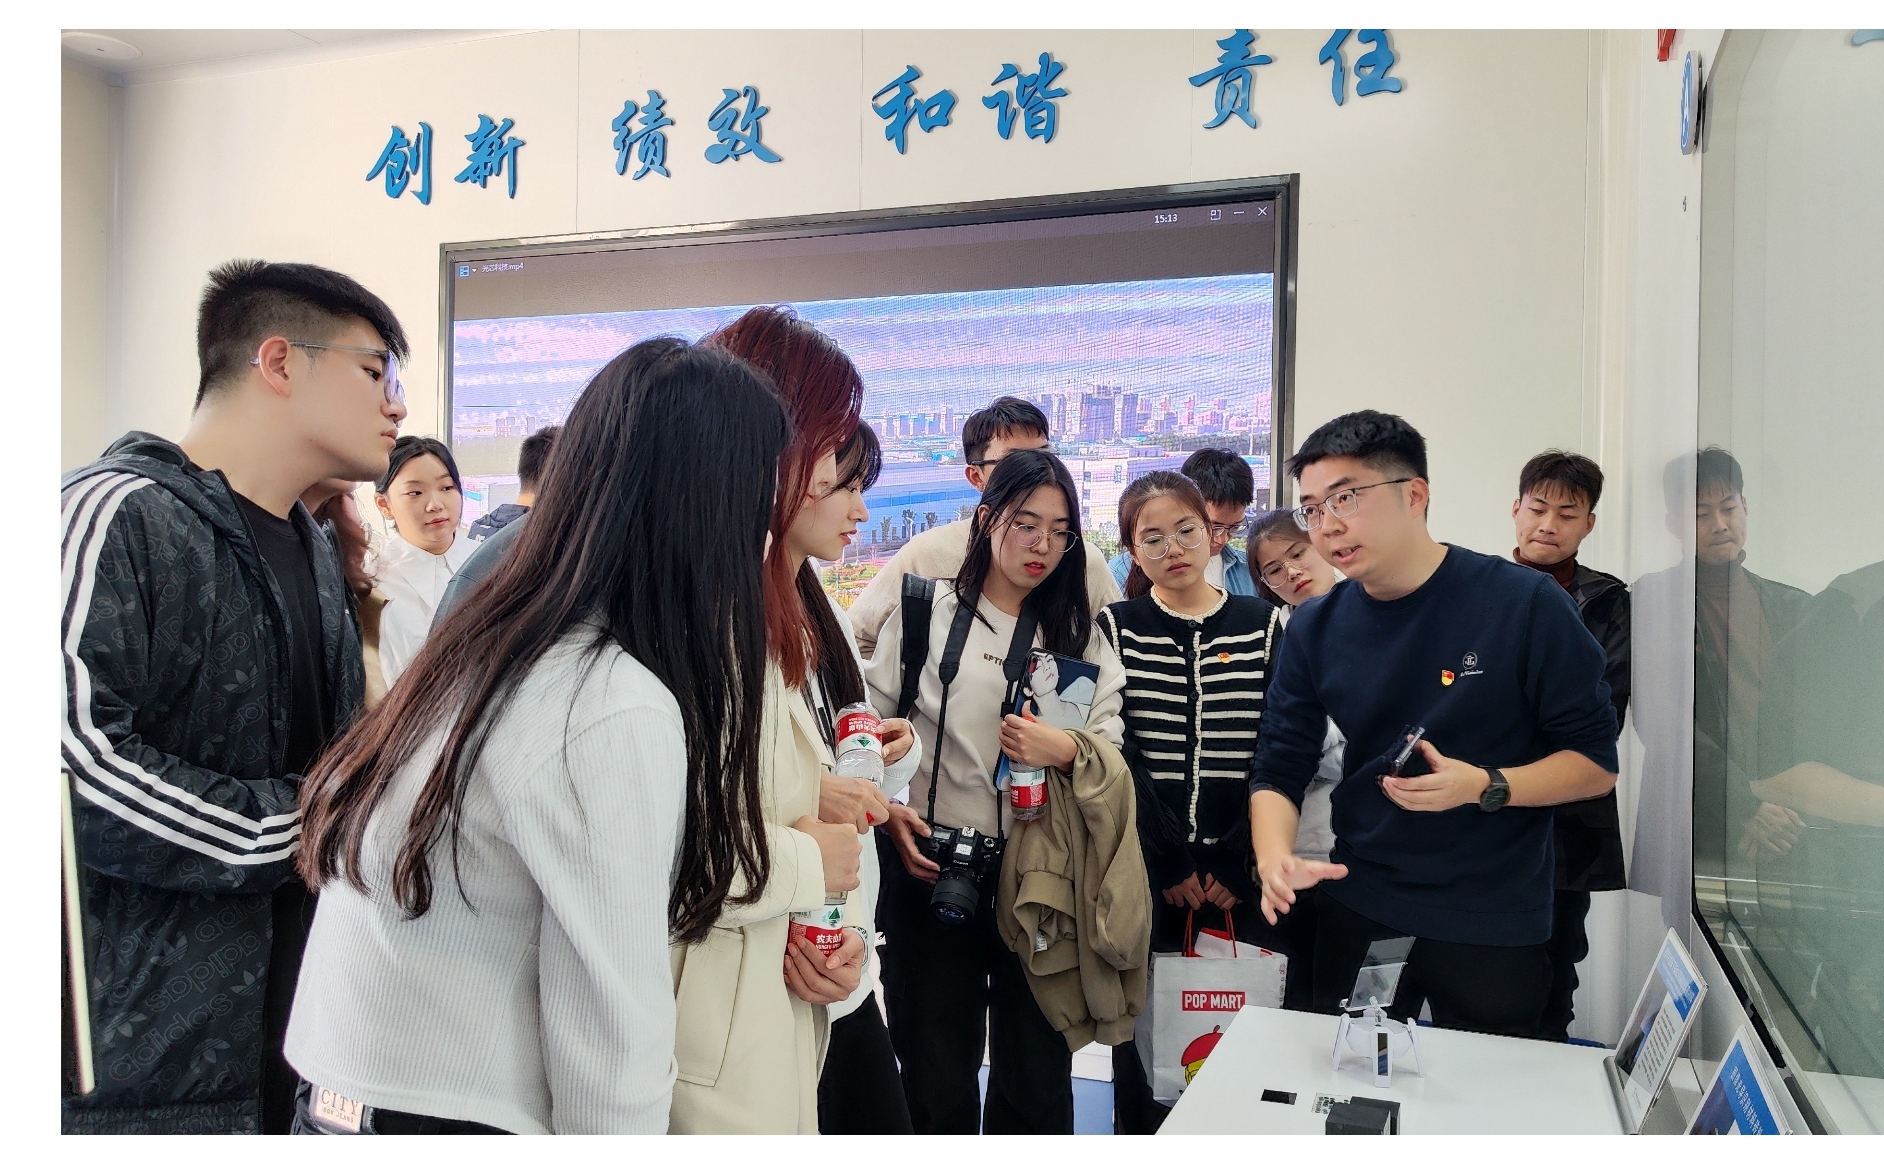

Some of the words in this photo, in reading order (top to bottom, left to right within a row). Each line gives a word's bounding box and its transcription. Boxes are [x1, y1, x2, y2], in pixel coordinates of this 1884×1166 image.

[366, 113, 527, 205] 创新
[612, 84, 783, 182] 绩效
[872, 51, 1069, 155] 和谐
[1188, 29, 1403, 130] 责任
[1154, 212, 1178, 224] 15:13
[1184, 994, 1208, 1009] POP
[1211, 994, 1243, 1010] MART
[321, 1089, 359, 1115] CITY
